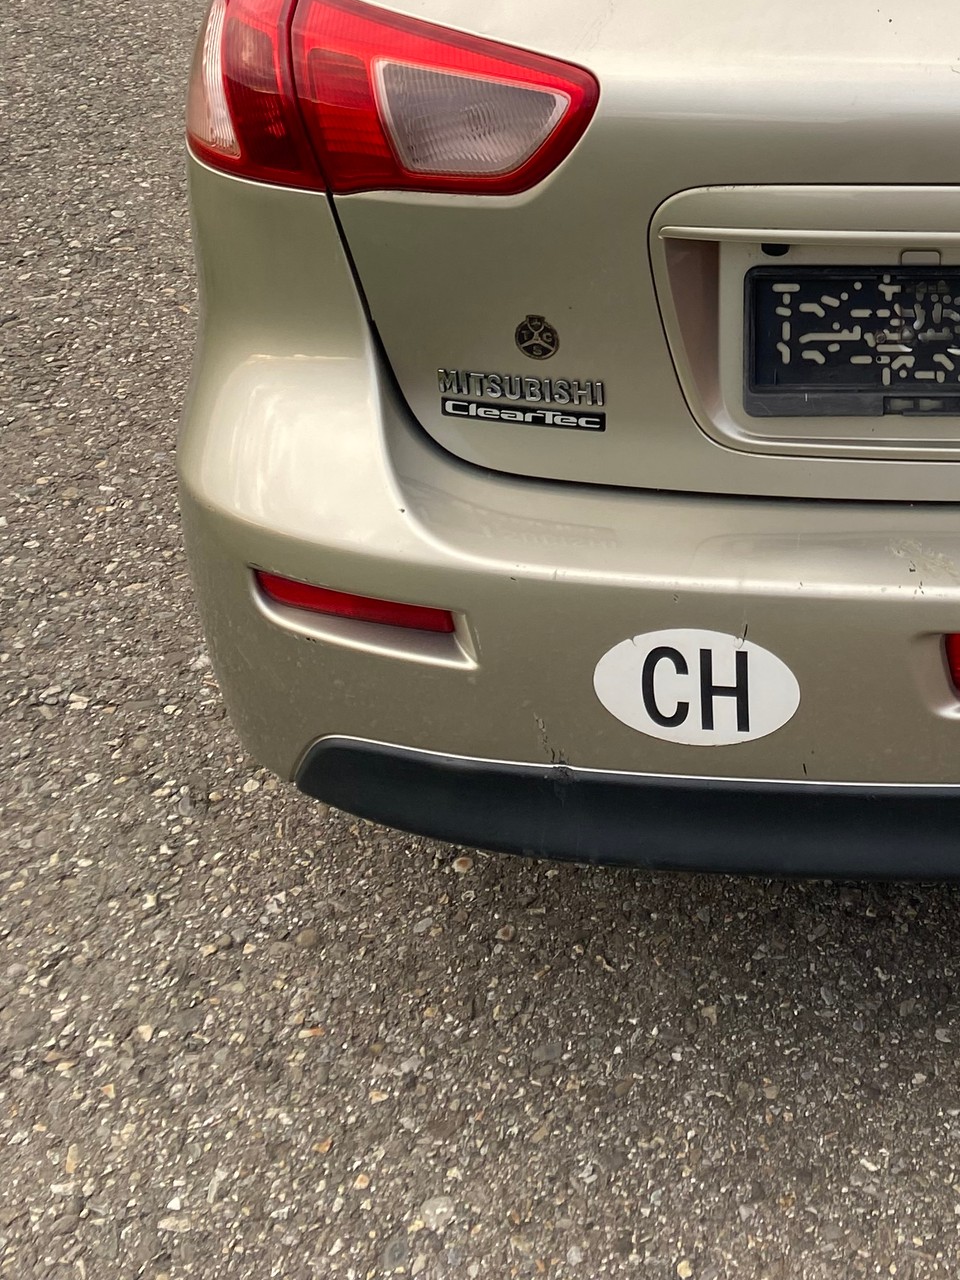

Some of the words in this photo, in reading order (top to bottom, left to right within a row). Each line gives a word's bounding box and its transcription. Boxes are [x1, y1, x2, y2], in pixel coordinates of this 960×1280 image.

[438, 368, 605, 406] MITSUBISHI
[445, 400, 601, 428] ClearTec
[642, 646, 750, 732] CH
